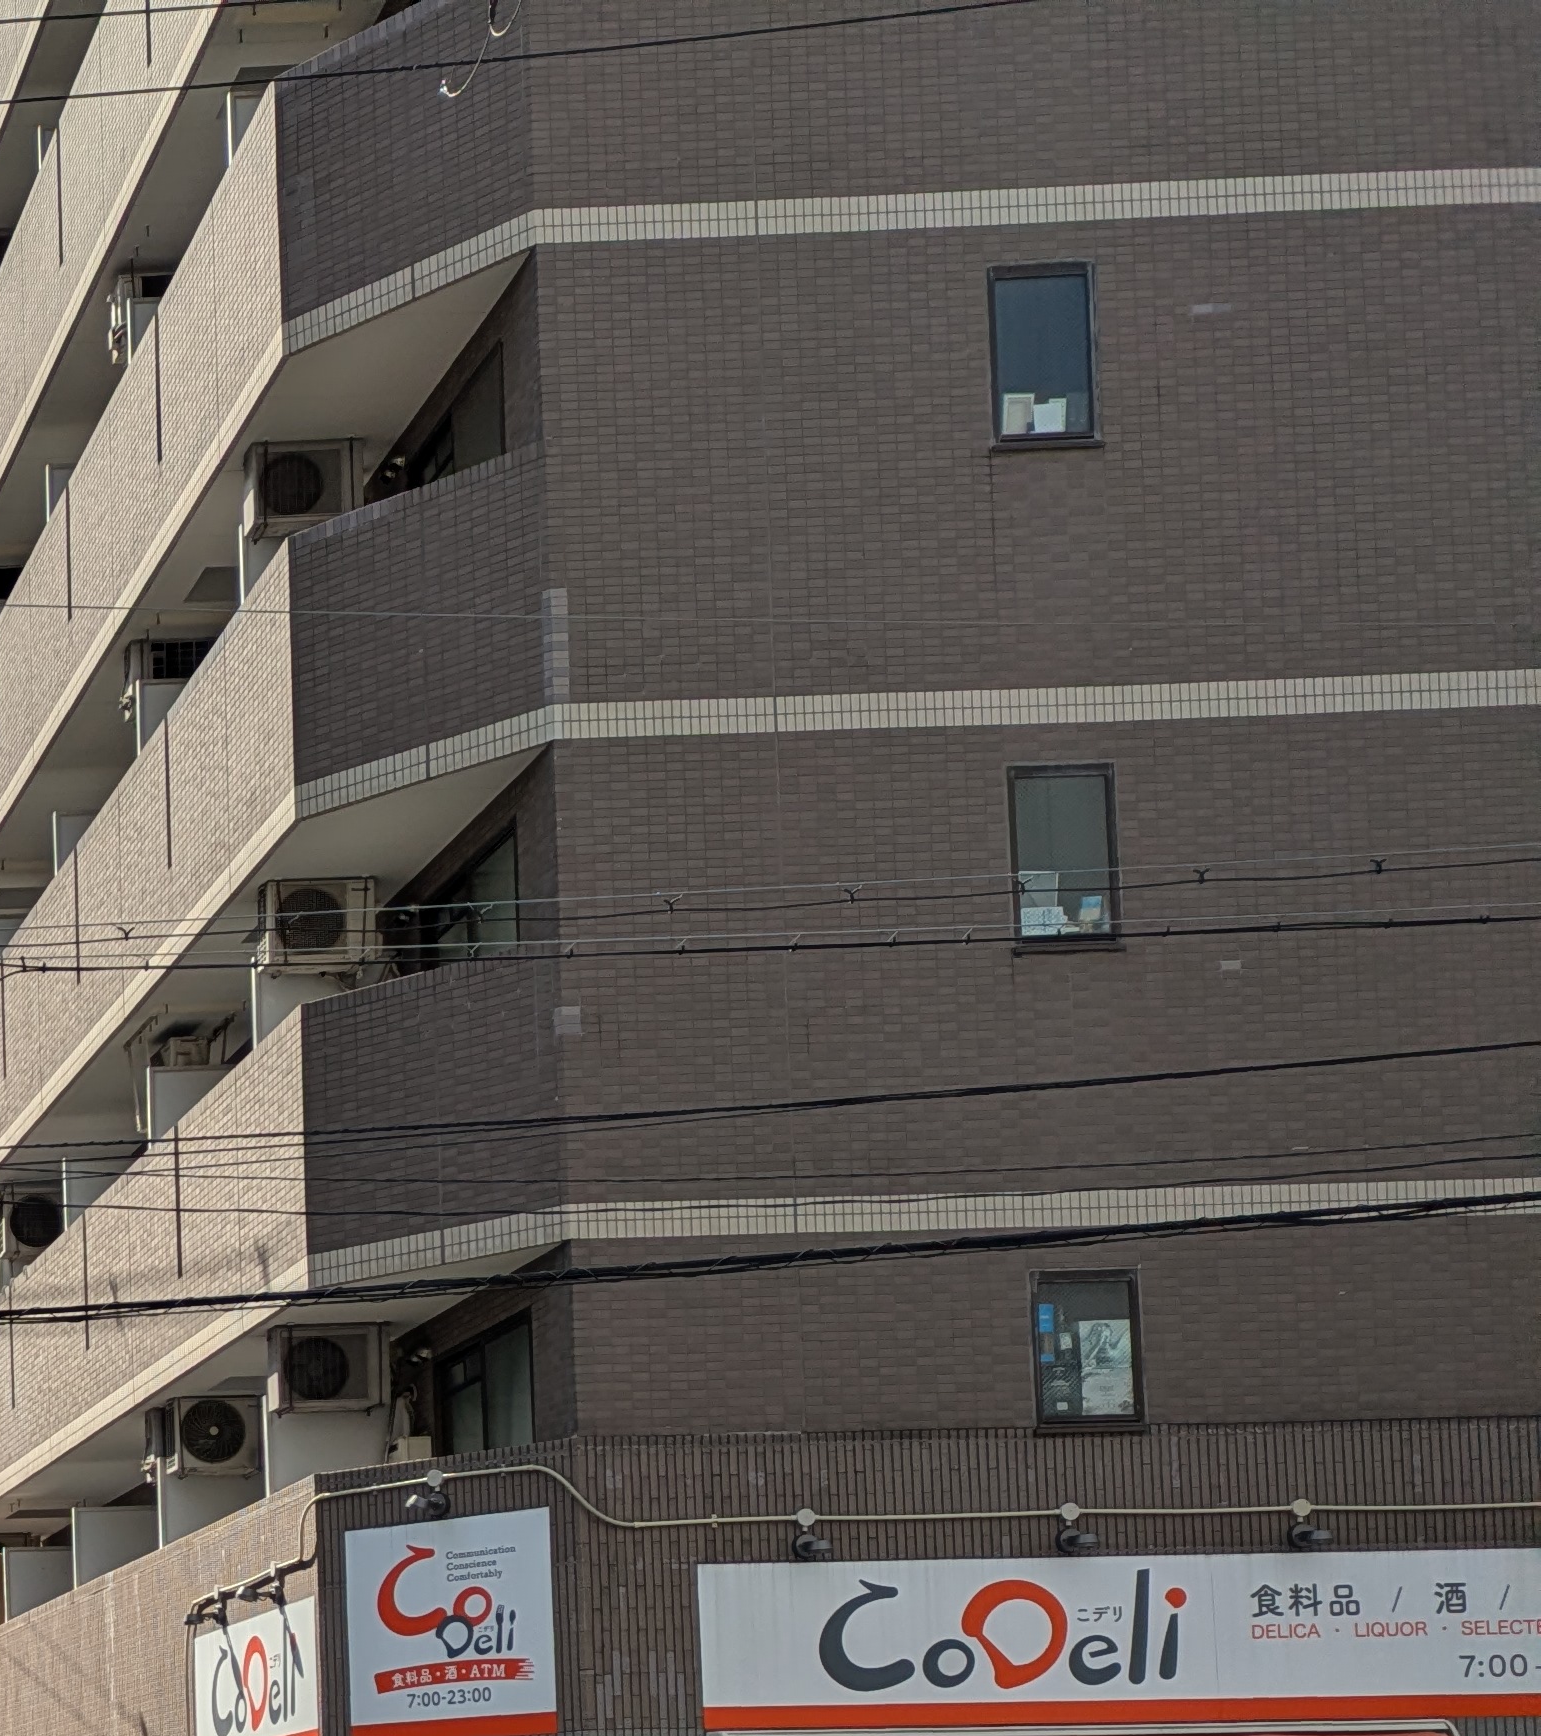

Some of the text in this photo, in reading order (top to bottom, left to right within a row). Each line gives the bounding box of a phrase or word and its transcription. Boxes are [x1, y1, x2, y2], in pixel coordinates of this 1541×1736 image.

[446, 1545, 517, 1560] Communication
[447, 1559, 497, 1571] Conscience
[447, 1569, 503, 1582] Comfortably
[1250, 1583, 1361, 1617] 食料品
[1434, 1582, 1467, 1615] 酒
[819, 1568, 1188, 1691] CoDeli
[1251, 1622, 1321, 1640] DELICA
[1354, 1620, 1428, 1639] LIQUOR
[407, 1687, 492, 1709] 7:00-23:00
